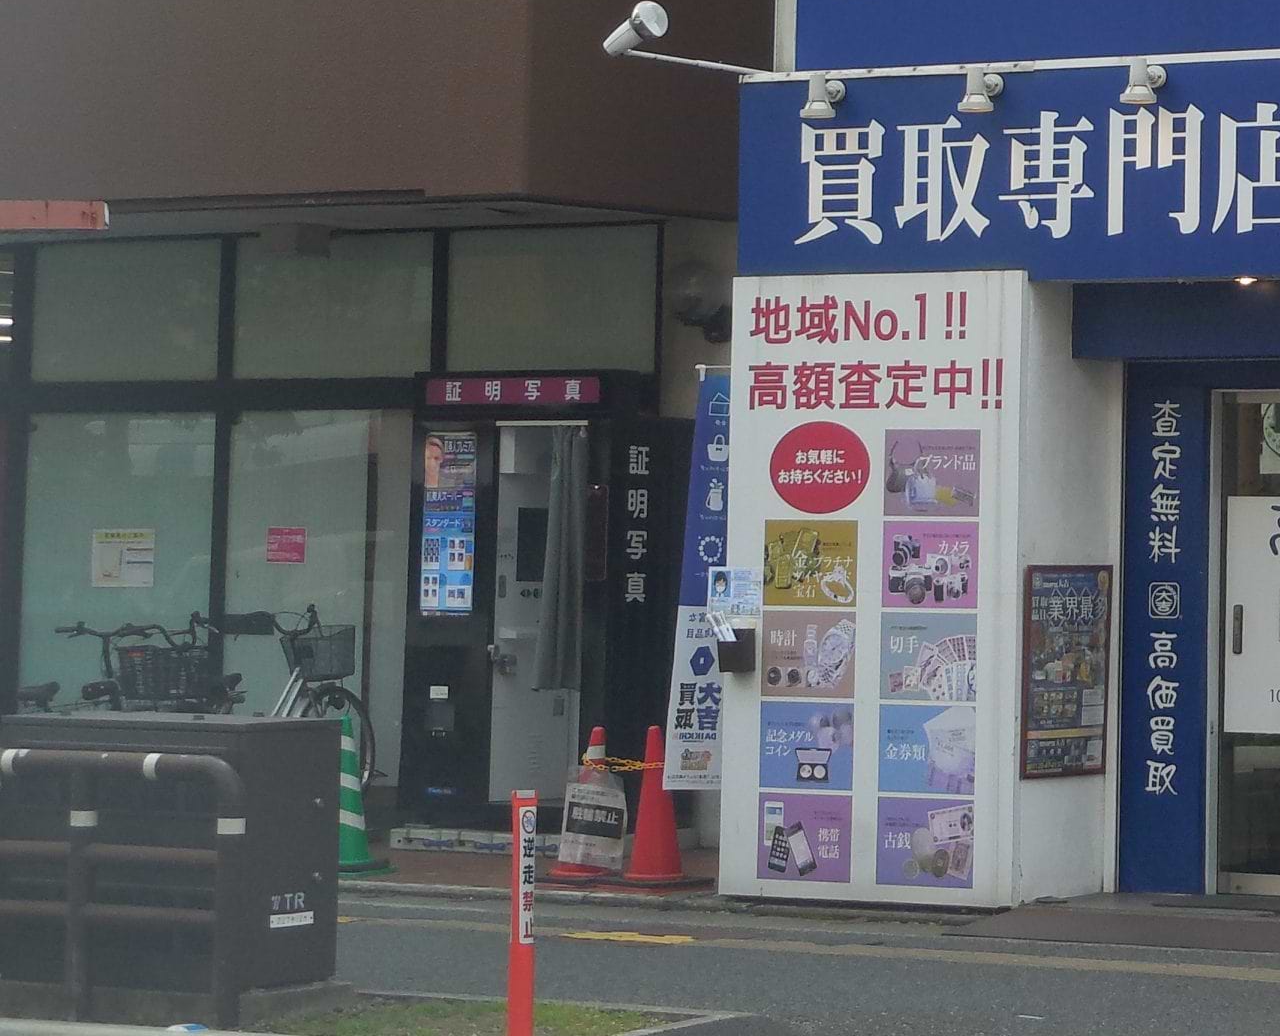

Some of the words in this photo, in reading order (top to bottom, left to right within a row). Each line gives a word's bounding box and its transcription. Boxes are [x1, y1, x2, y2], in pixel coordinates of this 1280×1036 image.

[446, 378, 582, 402] 証明写真
[795, 448, 845, 465] お気軽に
[920, 454, 977, 471] ブランド品
[777, 469, 862, 485] お持ちください!
[1148, 399, 1181, 564] 査定無料
[624, 444, 651, 604] 証明写真
[938, 540, 970, 555] カメラ
[793, 584, 816, 598] 宝石
[770, 629, 797, 647] 時計
[890, 635, 920, 654] 切手
[1144, 631, 1180, 796] 高価買取
[765, 728, 814, 743] 記念メダル
[765, 745, 791, 757] コイン
[884, 743, 927, 761] 金券類
[818, 827, 841, 842] 携帯
[884, 831, 912, 850] 古銭
[818, 844, 841, 859] 電話
[521, 836, 535, 940] 逆走禁止
